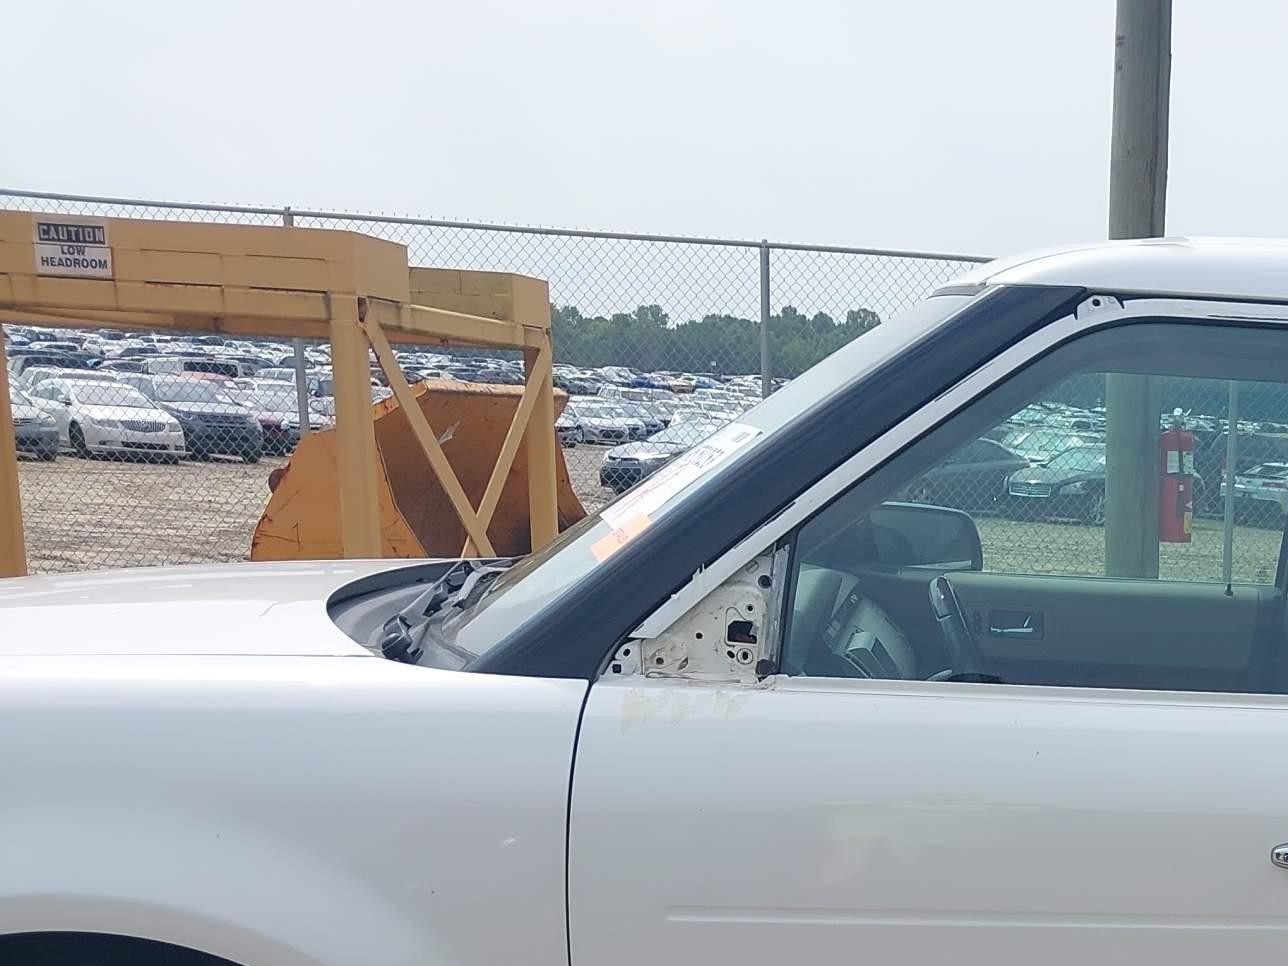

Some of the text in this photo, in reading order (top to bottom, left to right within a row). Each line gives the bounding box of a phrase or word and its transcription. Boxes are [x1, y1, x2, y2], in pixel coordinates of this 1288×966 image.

[39, 225, 104, 242] CAUTION
[61, 245, 86, 256] LOW
[41, 256, 108, 270] HEADROOM
